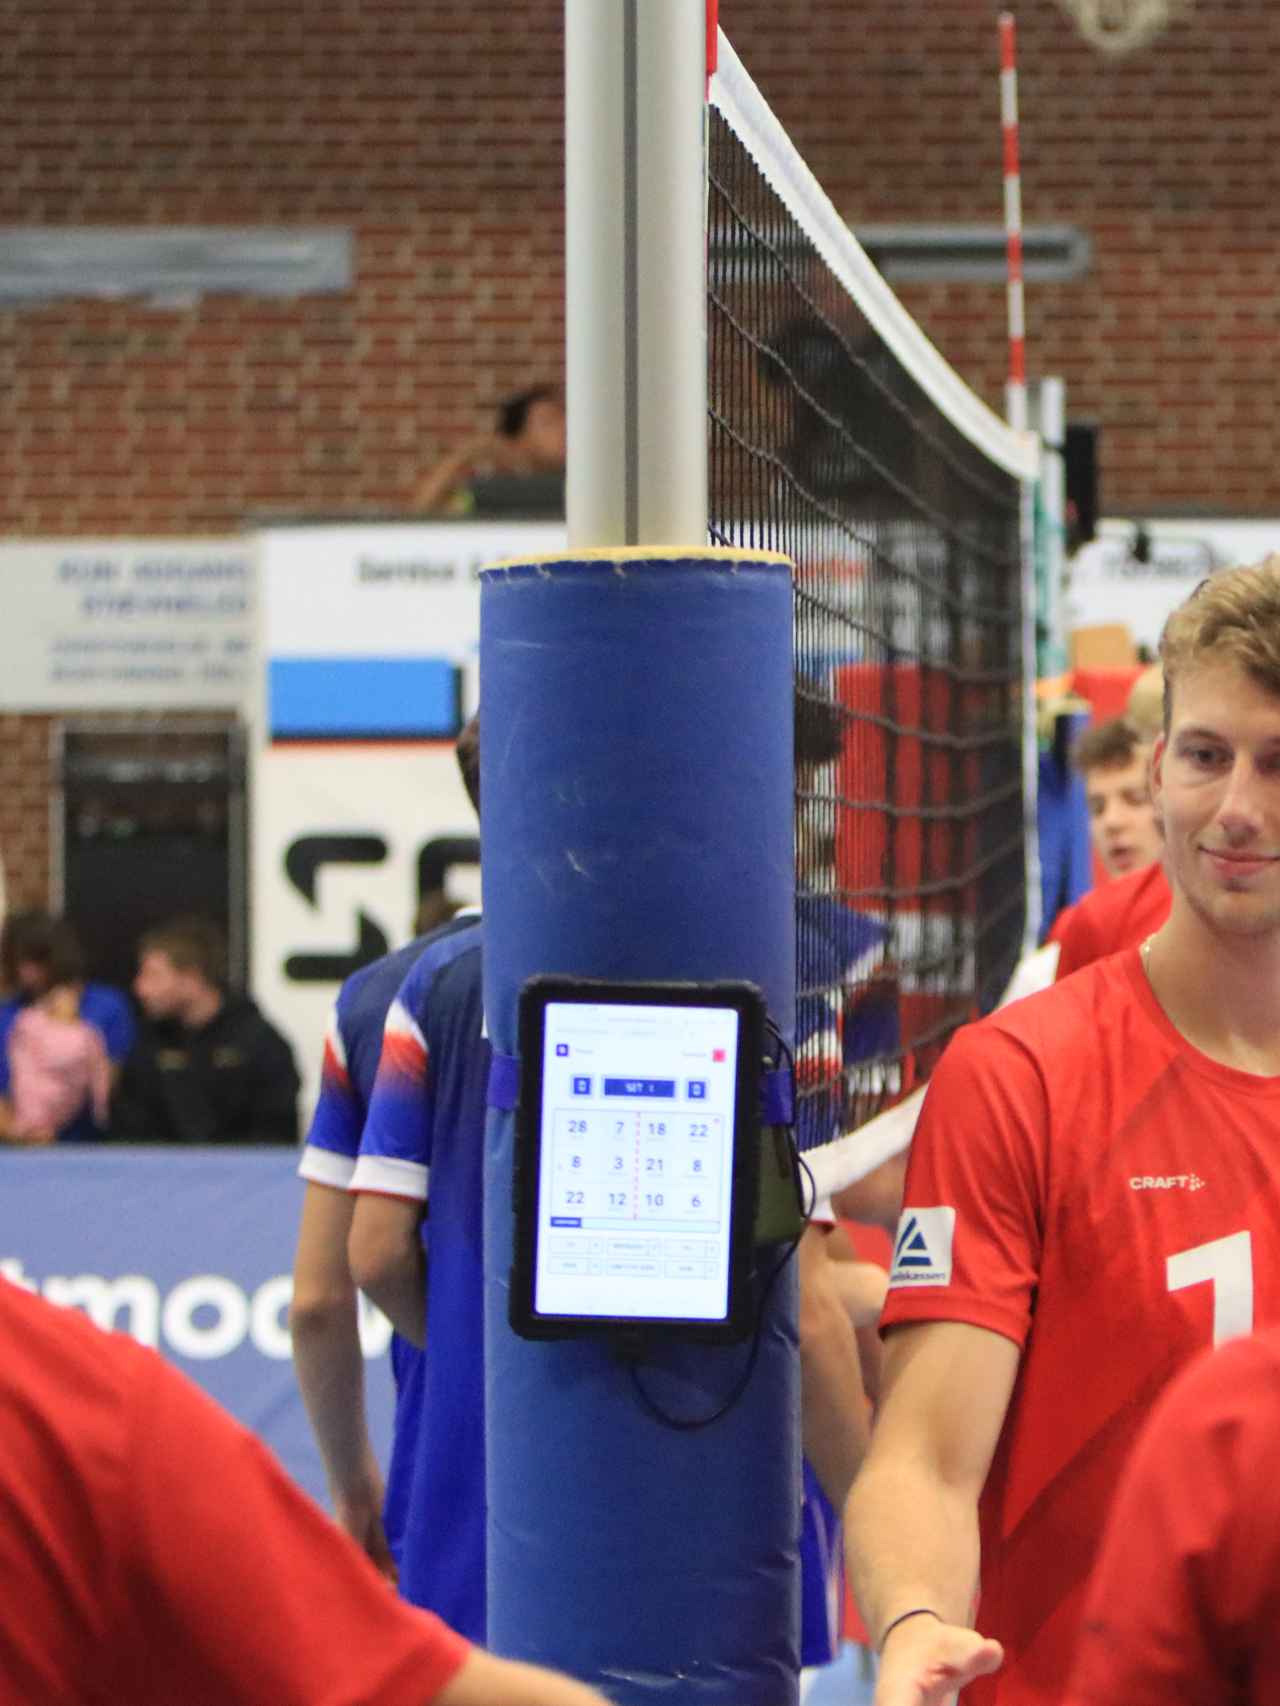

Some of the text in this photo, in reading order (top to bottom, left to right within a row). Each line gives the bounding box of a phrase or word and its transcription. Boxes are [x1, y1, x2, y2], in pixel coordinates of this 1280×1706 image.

[616, 1121, 625, 1135] 7
[648, 1122, 666, 1136] 18
[689, 1124, 709, 1137] 22
[613, 1157, 624, 1170] 3
[645, 1158, 664, 1171] 21
[1129, 1176, 1188, 1191] CRAFT
[565, 1191, 702, 1208] 22 12 10 6
